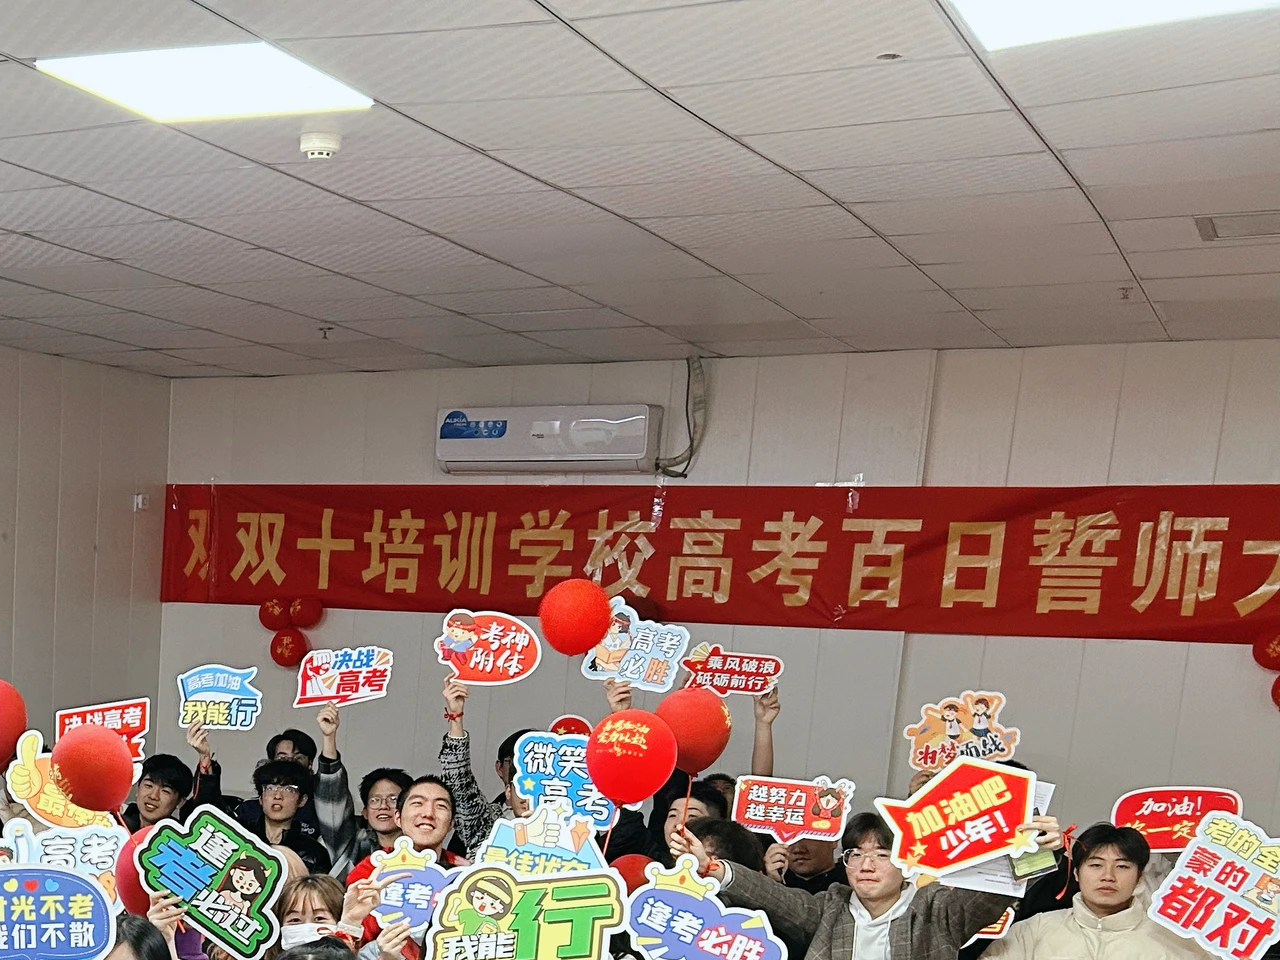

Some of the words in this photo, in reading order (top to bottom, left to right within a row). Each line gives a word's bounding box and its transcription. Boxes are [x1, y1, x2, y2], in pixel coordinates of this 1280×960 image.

[479, 621, 531, 651] 考神
[630, 627, 682, 659] 高考
[331, 649, 374, 670] 决战
[468, 646, 525, 676] 附体
[620, 654, 670, 686] 必胜
[705, 655, 776, 675] 乘风破浪
[186, 672, 242, 692] 高考加油
[335, 667, 389, 695] 高考
[695, 672, 766, 692] 砥砺前行
[182, 697, 260, 727] 我能行
[523, 741, 588, 779] 微笑
[748, 784, 807, 806] 越努力
[907, 775, 1012, 840] 加油吧
[745, 803, 806, 826] 越幸运
[39, 833, 120, 869] 高考
[1185, 845, 1251, 893] 蒙的
[380, 881, 440, 909] 逢考
[1158, 875, 1277, 959] 都对
